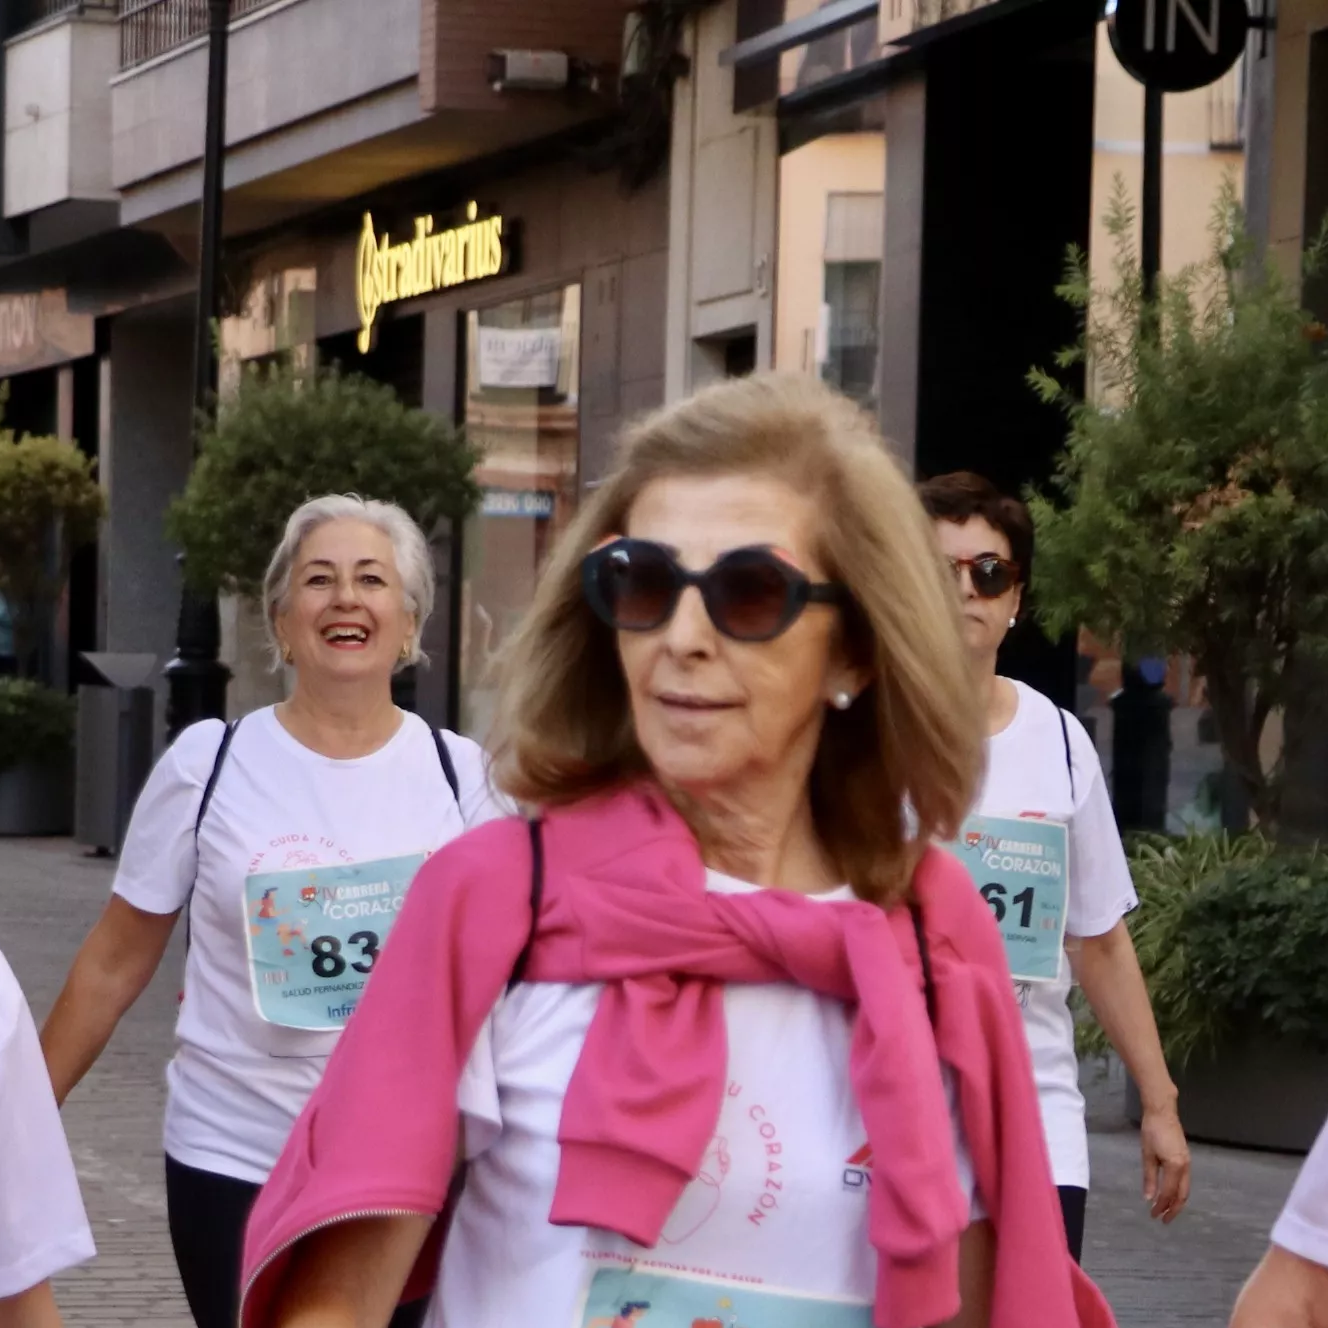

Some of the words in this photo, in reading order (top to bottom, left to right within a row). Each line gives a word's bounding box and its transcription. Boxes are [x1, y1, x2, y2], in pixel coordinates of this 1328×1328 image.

[1143, 0, 1218, 54] IN
[330, 895, 405, 920] CORAZO
[311, 930, 381, 978] 83
